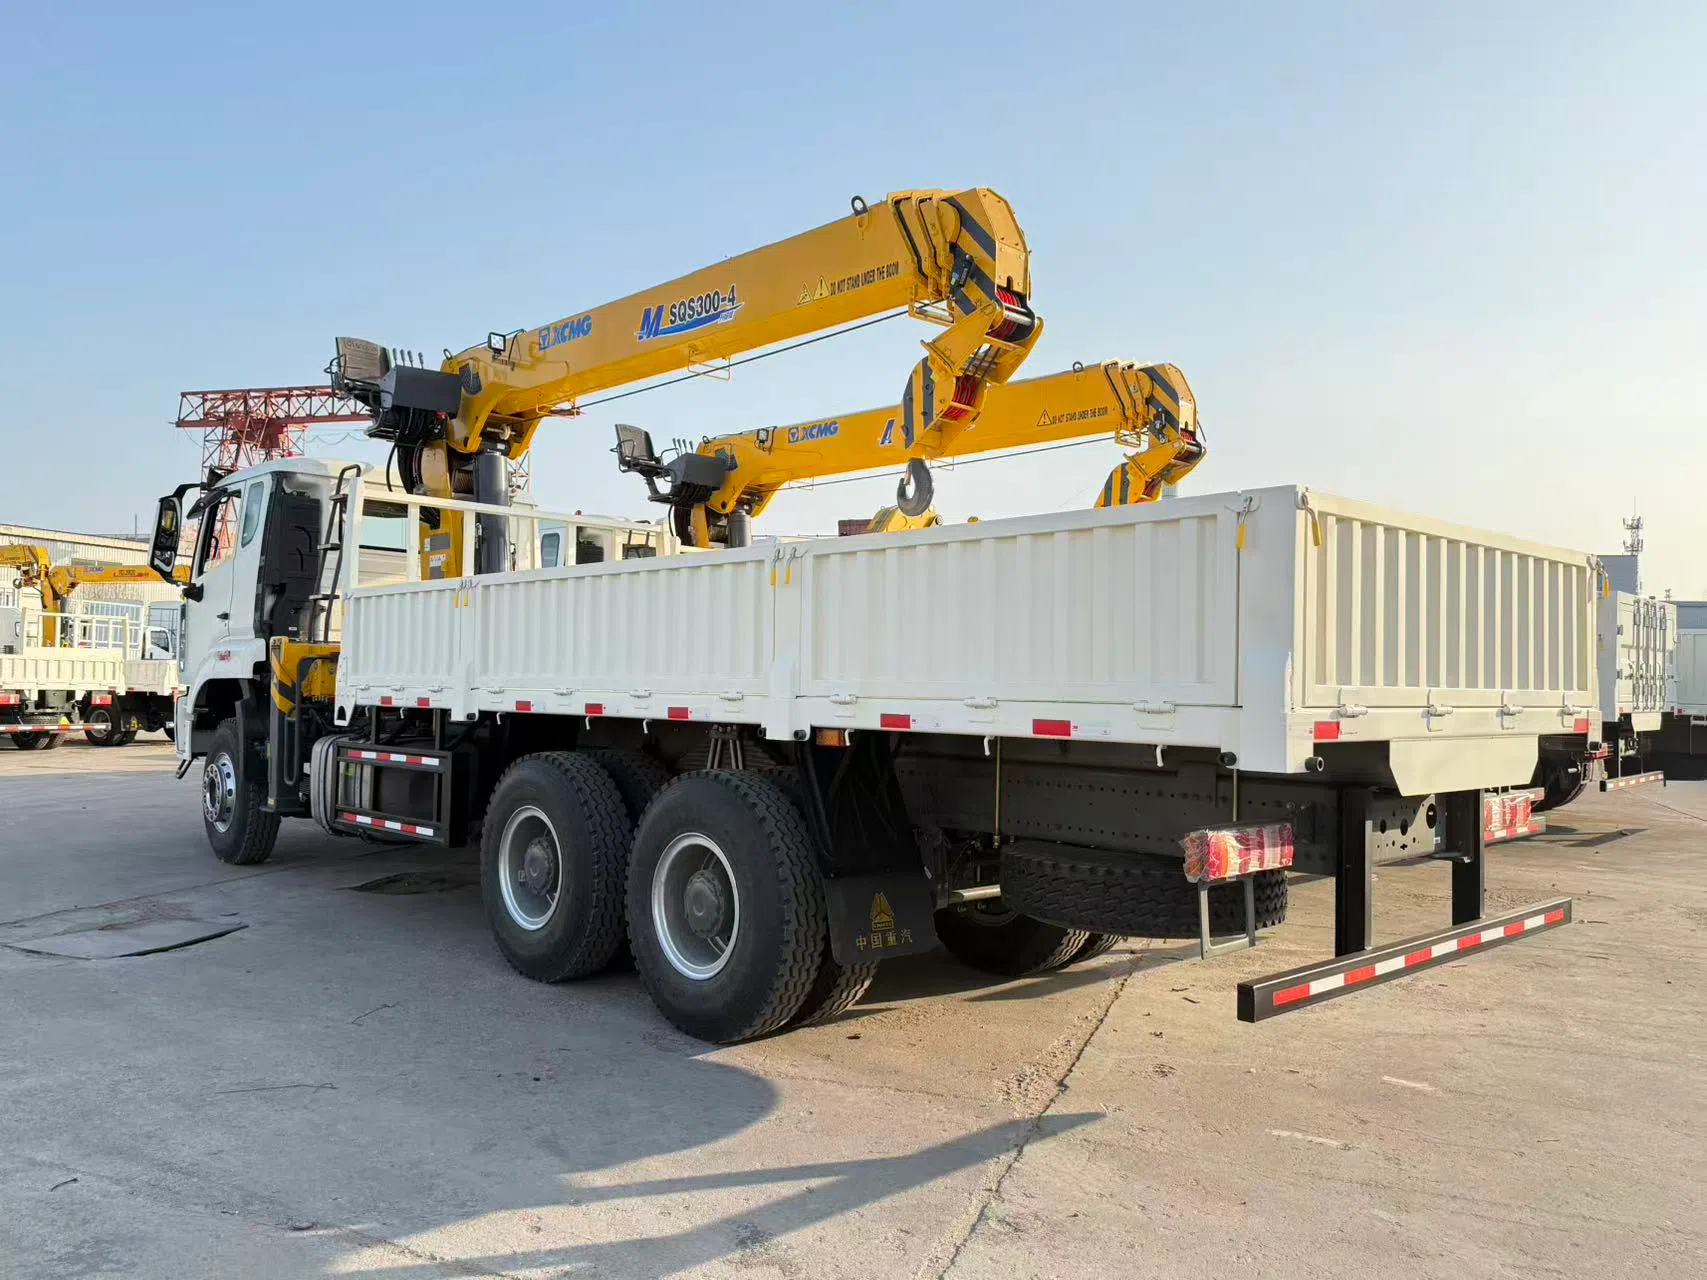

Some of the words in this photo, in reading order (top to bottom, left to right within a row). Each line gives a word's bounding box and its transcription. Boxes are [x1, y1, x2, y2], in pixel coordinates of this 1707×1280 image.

[830, 282, 837, 296] DO
[837, 278, 846, 294] NOT
[847, 273, 860, 290] STAND
[861, 268, 875, 286] UNDER
[876, 265, 885, 280] THE
[886, 260, 899, 278] BOOM
[669, 284, 736, 325] SQS300-4
[552, 314, 593, 346] XCMG
[802, 421, 839, 441] XCMG
[856, 928, 913, 950] 中国重汽
